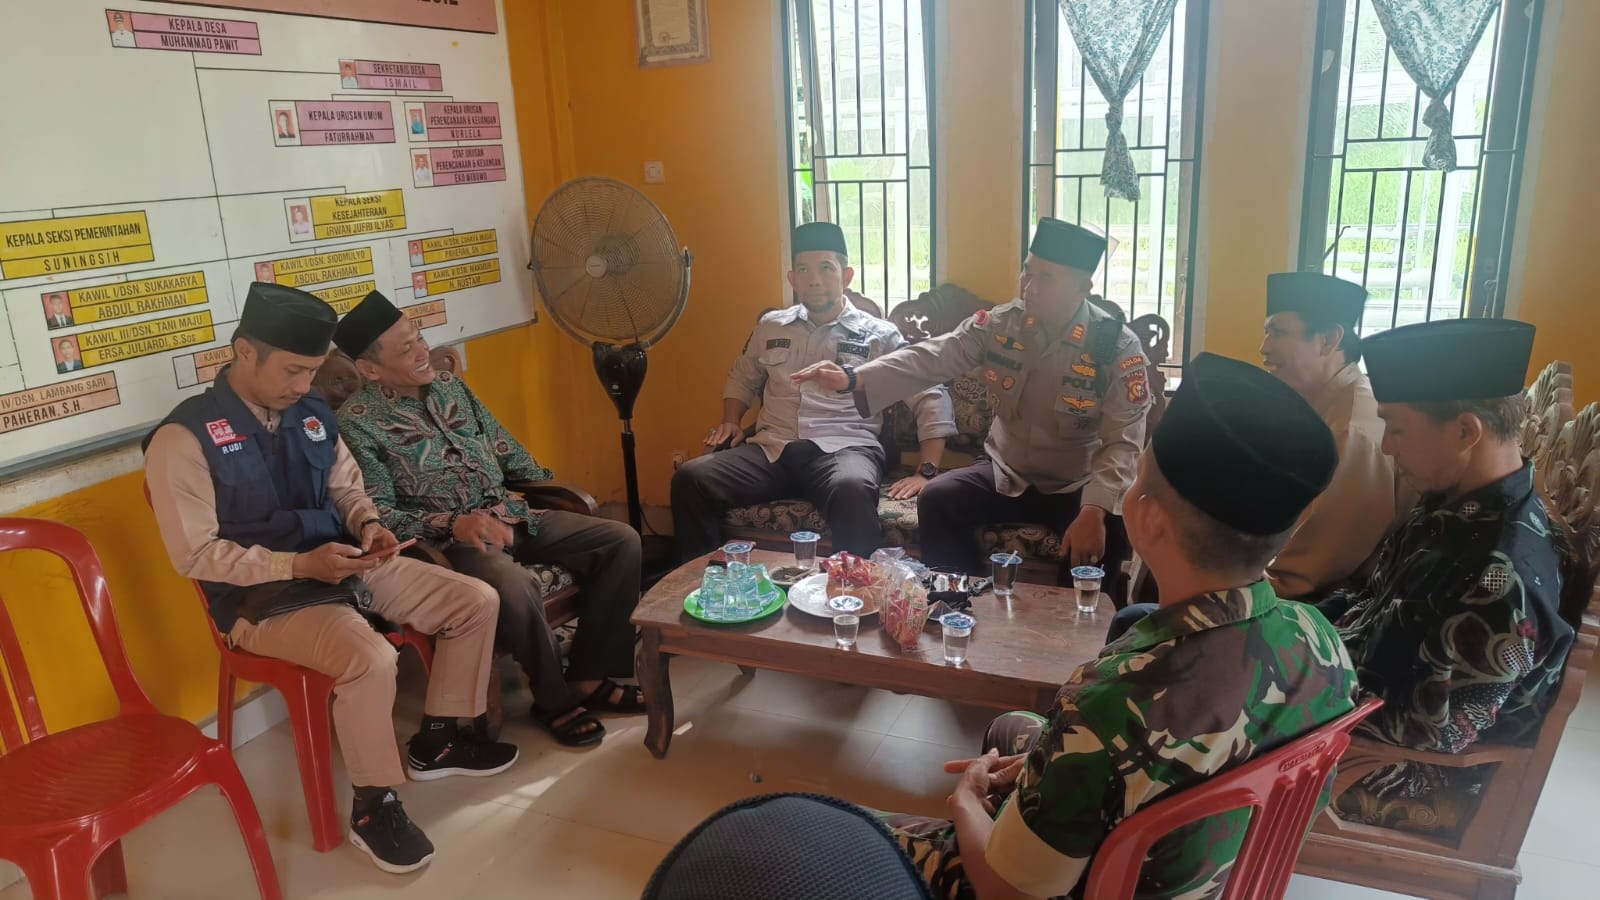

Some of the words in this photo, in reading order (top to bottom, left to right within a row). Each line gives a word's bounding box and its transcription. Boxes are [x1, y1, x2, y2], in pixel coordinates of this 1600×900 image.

[168, 18, 202, 32] KEPALA
[205, 20, 227, 34] DESA
[160, 34, 212, 49] MUHAMMAD
[214, 38, 239, 51] PAWIT
[373, 63, 409, 75] SEKRETARIS
[411, 65, 426, 75] DESA
[308, 110, 335, 120] KEPALA
[336, 110, 364, 120] URUSAN
[364, 110, 383, 120] UMUM
[443, 105, 462, 114] KEPALA
[463, 105, 482, 113] URUSAN
[430, 116, 466, 125] PERENCANAAN
[335, 197, 361, 207] KEPALA
[332, 207, 387, 220] KESEJAHTERAAN
[327, 223, 351, 236] IRWAN
[375, 219, 394, 230] ILYAS
[6, 232, 45, 248] KEPALA
[46, 229, 73, 244] SEKSI
[75, 223, 141, 240] PEMERINTAHAN
[280, 260, 304, 271] KAWIL
[294, 273, 320, 285] ABDUL
[322, 266, 358, 280] RAKHMAN
[78, 288, 111, 303] KAWIL
[144, 275, 198, 293] SUKAKARYA
[98, 304, 134, 319] ABDUL
[137, 294, 187, 310] RAKHMAN
[85, 331, 117, 346] KAWIL
[156, 318, 176, 332] TANI
[178, 314, 203, 328] MAJU
[98, 346, 124, 360] ERSA
[204, 350, 228, 362] KAWIL
[40, 383, 84, 400] LAMBANG
[86, 378, 106, 390] SARI
